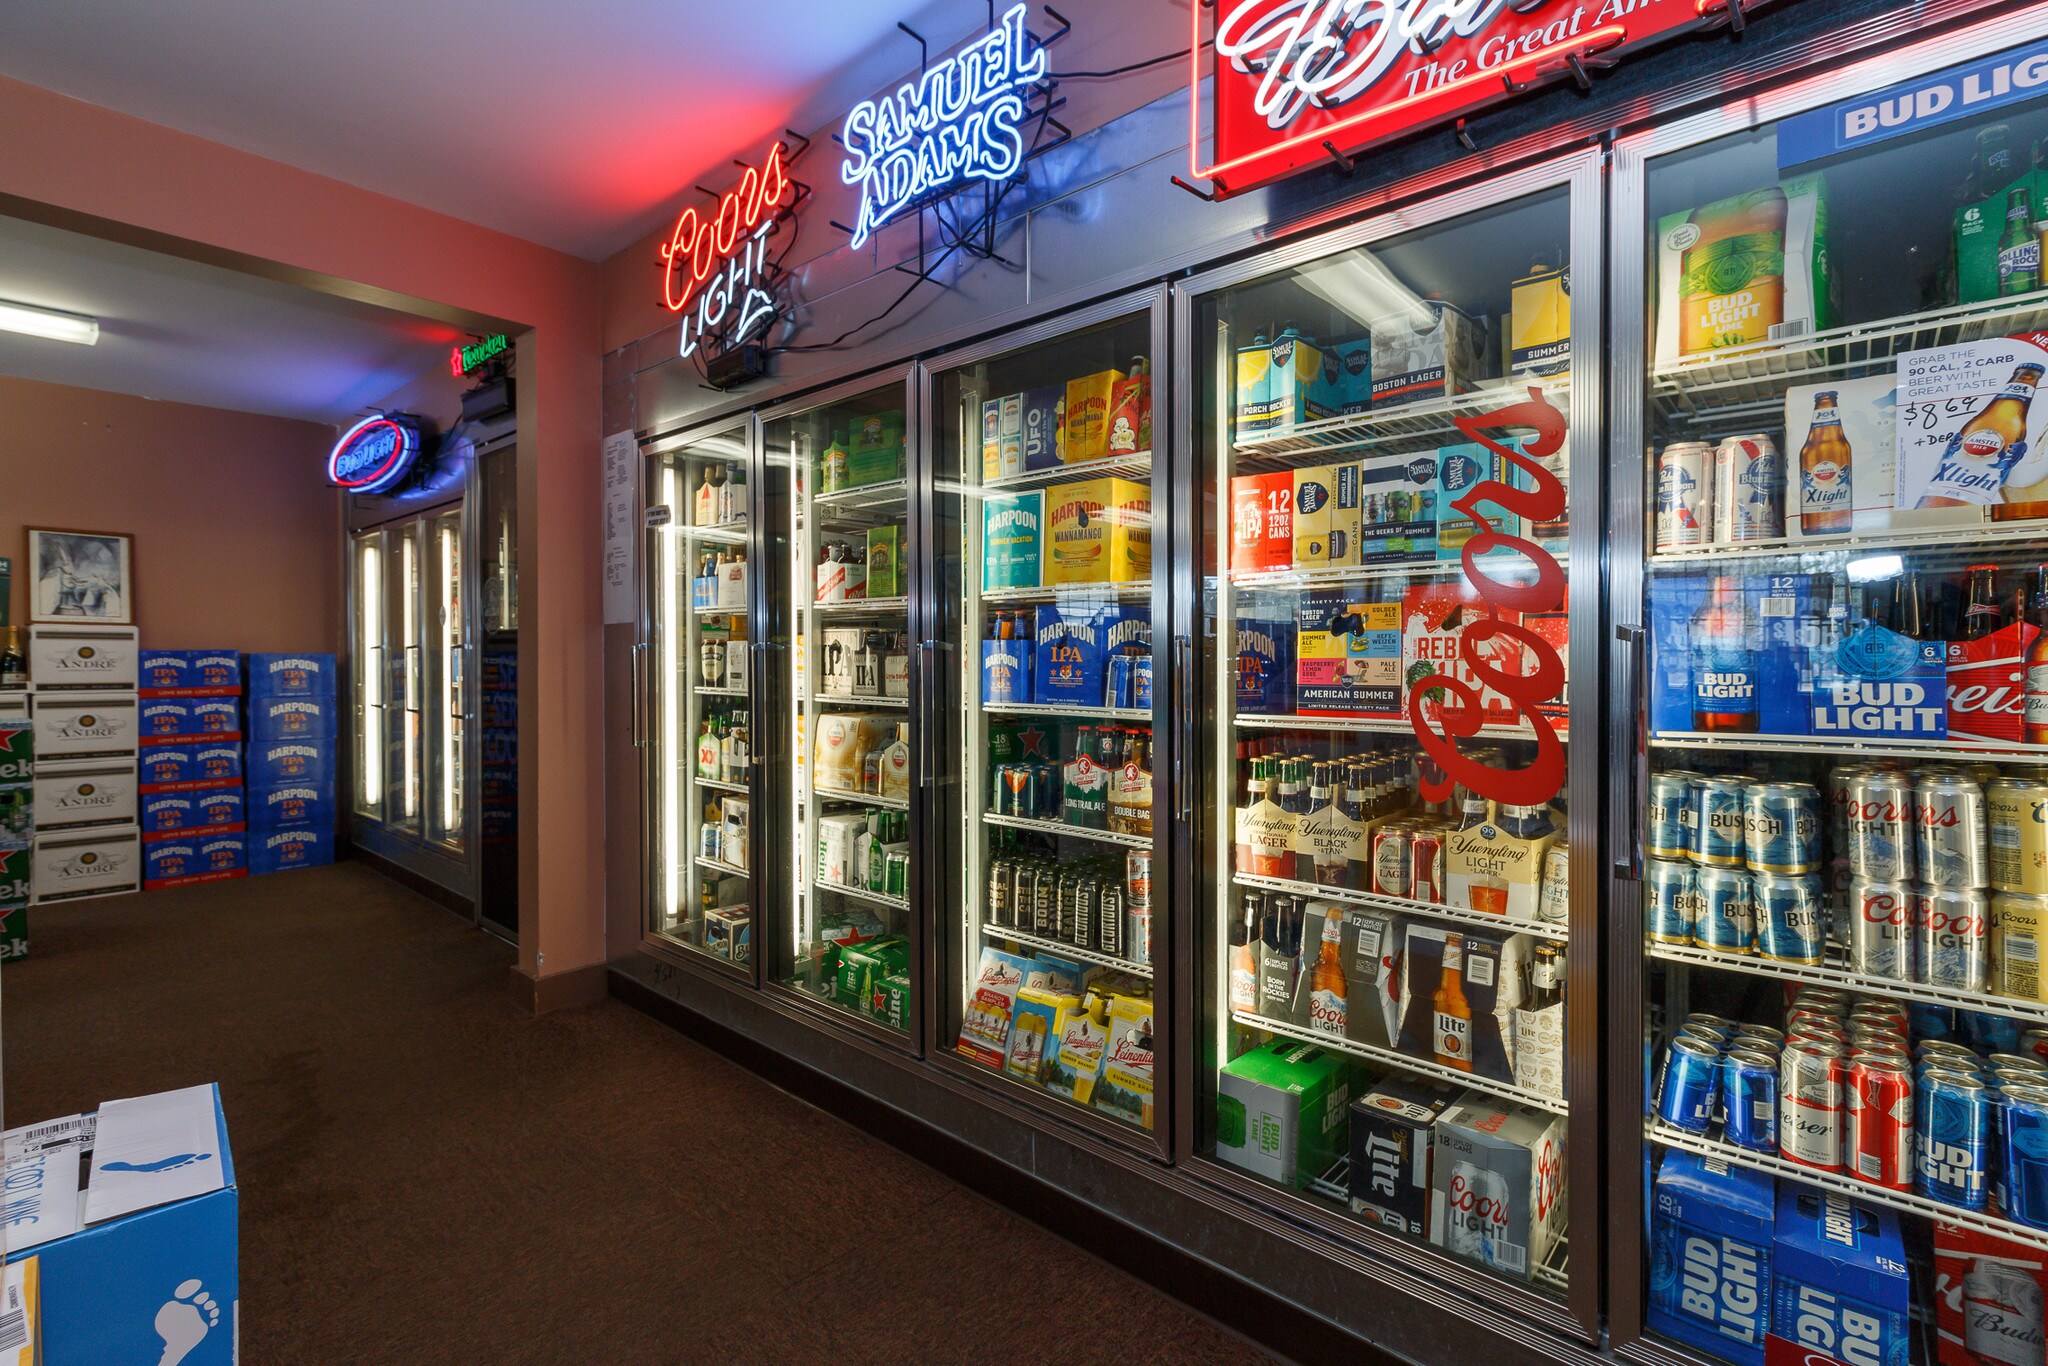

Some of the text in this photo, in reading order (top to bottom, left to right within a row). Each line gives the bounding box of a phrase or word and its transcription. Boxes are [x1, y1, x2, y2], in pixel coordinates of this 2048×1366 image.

[1405, 61, 1468, 98] The
[1475, 20, 1592, 70] Great
[842, 2, 1045, 186] SAMUEL
[1845, 84, 1962, 139] BUD
[850, 96, 1024, 250] ADAMS
[1964, 208, 1980, 222] 6
[662, 141, 789, 311] Coors
[1962, 219, 1983, 228] PACK
[2012, 253, 2036, 265] ROCK
[680, 220, 772, 357] LIGHT
[1708, 292, 1753, 312] BUD
[1701, 303, 1761, 328] LIGHT
[1715, 321, 1744, 333] LIME
[1273, 341, 1292, 354] SAMUEL
[1274, 349, 1291, 359] ADAMS
[1528, 343, 1569, 359] SUMMER
[1909, 349, 1976, 366] GRAB THE
[1909, 367, 1925, 376] 90
[1964, 361, 1971, 369] 2
[1975, 354, 2014, 367] CARB
[1373, 370, 1441, 393] BOSTON LAGER
[1909, 370, 1981, 387] BEER WITH
[1908, 378, 1997, 397] GREAT TASTE
[1244, 399, 1291, 414] PORCH ROCKER
[1028, 408, 1041, 456] UFO
[1969, 438, 2000, 448] AMSTEL
[1409, 463, 1435, 472] SAMUEL
[1448, 456, 1458, 490] SAMUEL
[1931, 462, 1998, 491] Xlight
[1268, 489, 1290, 514] 12
[1303, 483, 1312, 513] SAMUEL
[1806, 488, 1847, 503] Xlight
[987, 509, 1037, 536] HARPOON
[1011, 536, 1033, 544] VACATION
[1055, 528, 1102, 543] WANNAMANGO
[1269, 526, 1290, 539] CANS
[1771, 577, 1793, 589] 12
[1408, 385, 1566, 808] Coors
[1040, 622, 1095, 646] HARPOON
[1051, 646, 1083, 663] IPA
[1924, 646, 1934, 657] 6
[1949, 645, 1961, 656] 6
[144, 657, 187, 669] HARPOON
[196, 657, 236, 668] HARPOON
[270, 659, 319, 673] HARPOON
[985, 653, 1018, 670] HARPOON
[1239, 657, 1263, 673] IPA
[154, 669, 178, 677] IPA
[204, 668, 228, 676] IPA
[991, 667, 1011, 677] IPA
[1704, 673, 1747, 685] BUD
[1304, 690, 1394, 699] AMERICAN SUMMER
[1698, 685, 1754, 698] LIGHT
[1832, 683, 1925, 706] BUD
[144, 705, 187, 717] HARPOON
[195, 703, 235, 715] HARPOON
[270, 702, 320, 717] HARPOON
[154, 716, 178, 724] IPA
[204, 714, 227, 722] IPA
[284, 713, 307, 721] IPA
[1815, 707, 1943, 731] LIGHT
[701, 749, 717, 764] XX
[1065, 798, 1106, 812] LONG TRAIL ALE
[1115, 806, 1150, 819] DOUBLE BAG
[1990, 801, 2019, 813] Coors
[1238, 811, 1297, 834] Yuengling
[1299, 819, 1365, 842] Yuengling
[1482, 827, 1494, 835] 99
[1250, 835, 1288, 848] LAGER
[1314, 839, 1347, 849] BLACK
[1450, 835, 1529, 863] Yuengling
[1466, 856, 1506, 872] LIGHT
[1474, 868, 1499, 877] LAGER
[1038, 886, 1049, 928] BOOM
[1102, 897, 1115, 952] GLORIOUS
[1353, 917, 1361, 926] 12
[2002, 911, 2038, 925] Coors
[1467, 941, 1478, 950] 12
[1264, 958, 1269, 966] 6
[1267, 976, 1285, 986] BORN
[1262, 985, 1290, 999] ROCKIES
[981, 996, 1005, 1007] SAMPLER
[1310, 999, 1347, 1025] Coors
[1315, 1021, 1343, 1035] LIGHT
[1439, 1014, 1465, 1033] Lite
[1521, 1027, 1536, 1037] Lite
[1061, 1054, 1095, 1070] SUMMER SHANDY
[1113, 1073, 1136, 1087] SUMMER
[1521, 1079, 1536, 1090] Lite
[1327, 1084, 1348, 1112] BUD
[1322, 1101, 1348, 1134] LIGHT
[1251, 1118, 1259, 1141] LIME
[1261, 1114, 1271, 1153] LIGHT
[1271, 1123, 1280, 1151] BUD
[1439, 1134, 1450, 1147] 18
[1916, 1131, 1973, 1167] BUD
[1366, 1132, 1400, 1197] Lite
[1449, 1175, 1509, 1226] Coors
[1659, 1195, 1673, 1213] 18
[1410, 1220, 1421, 1234] 18
[1453, 1212, 1503, 1240] LIGHT
[1682, 1237, 1719, 1320] BUD
[1719, 1236, 1758, 1344] LIGHT
